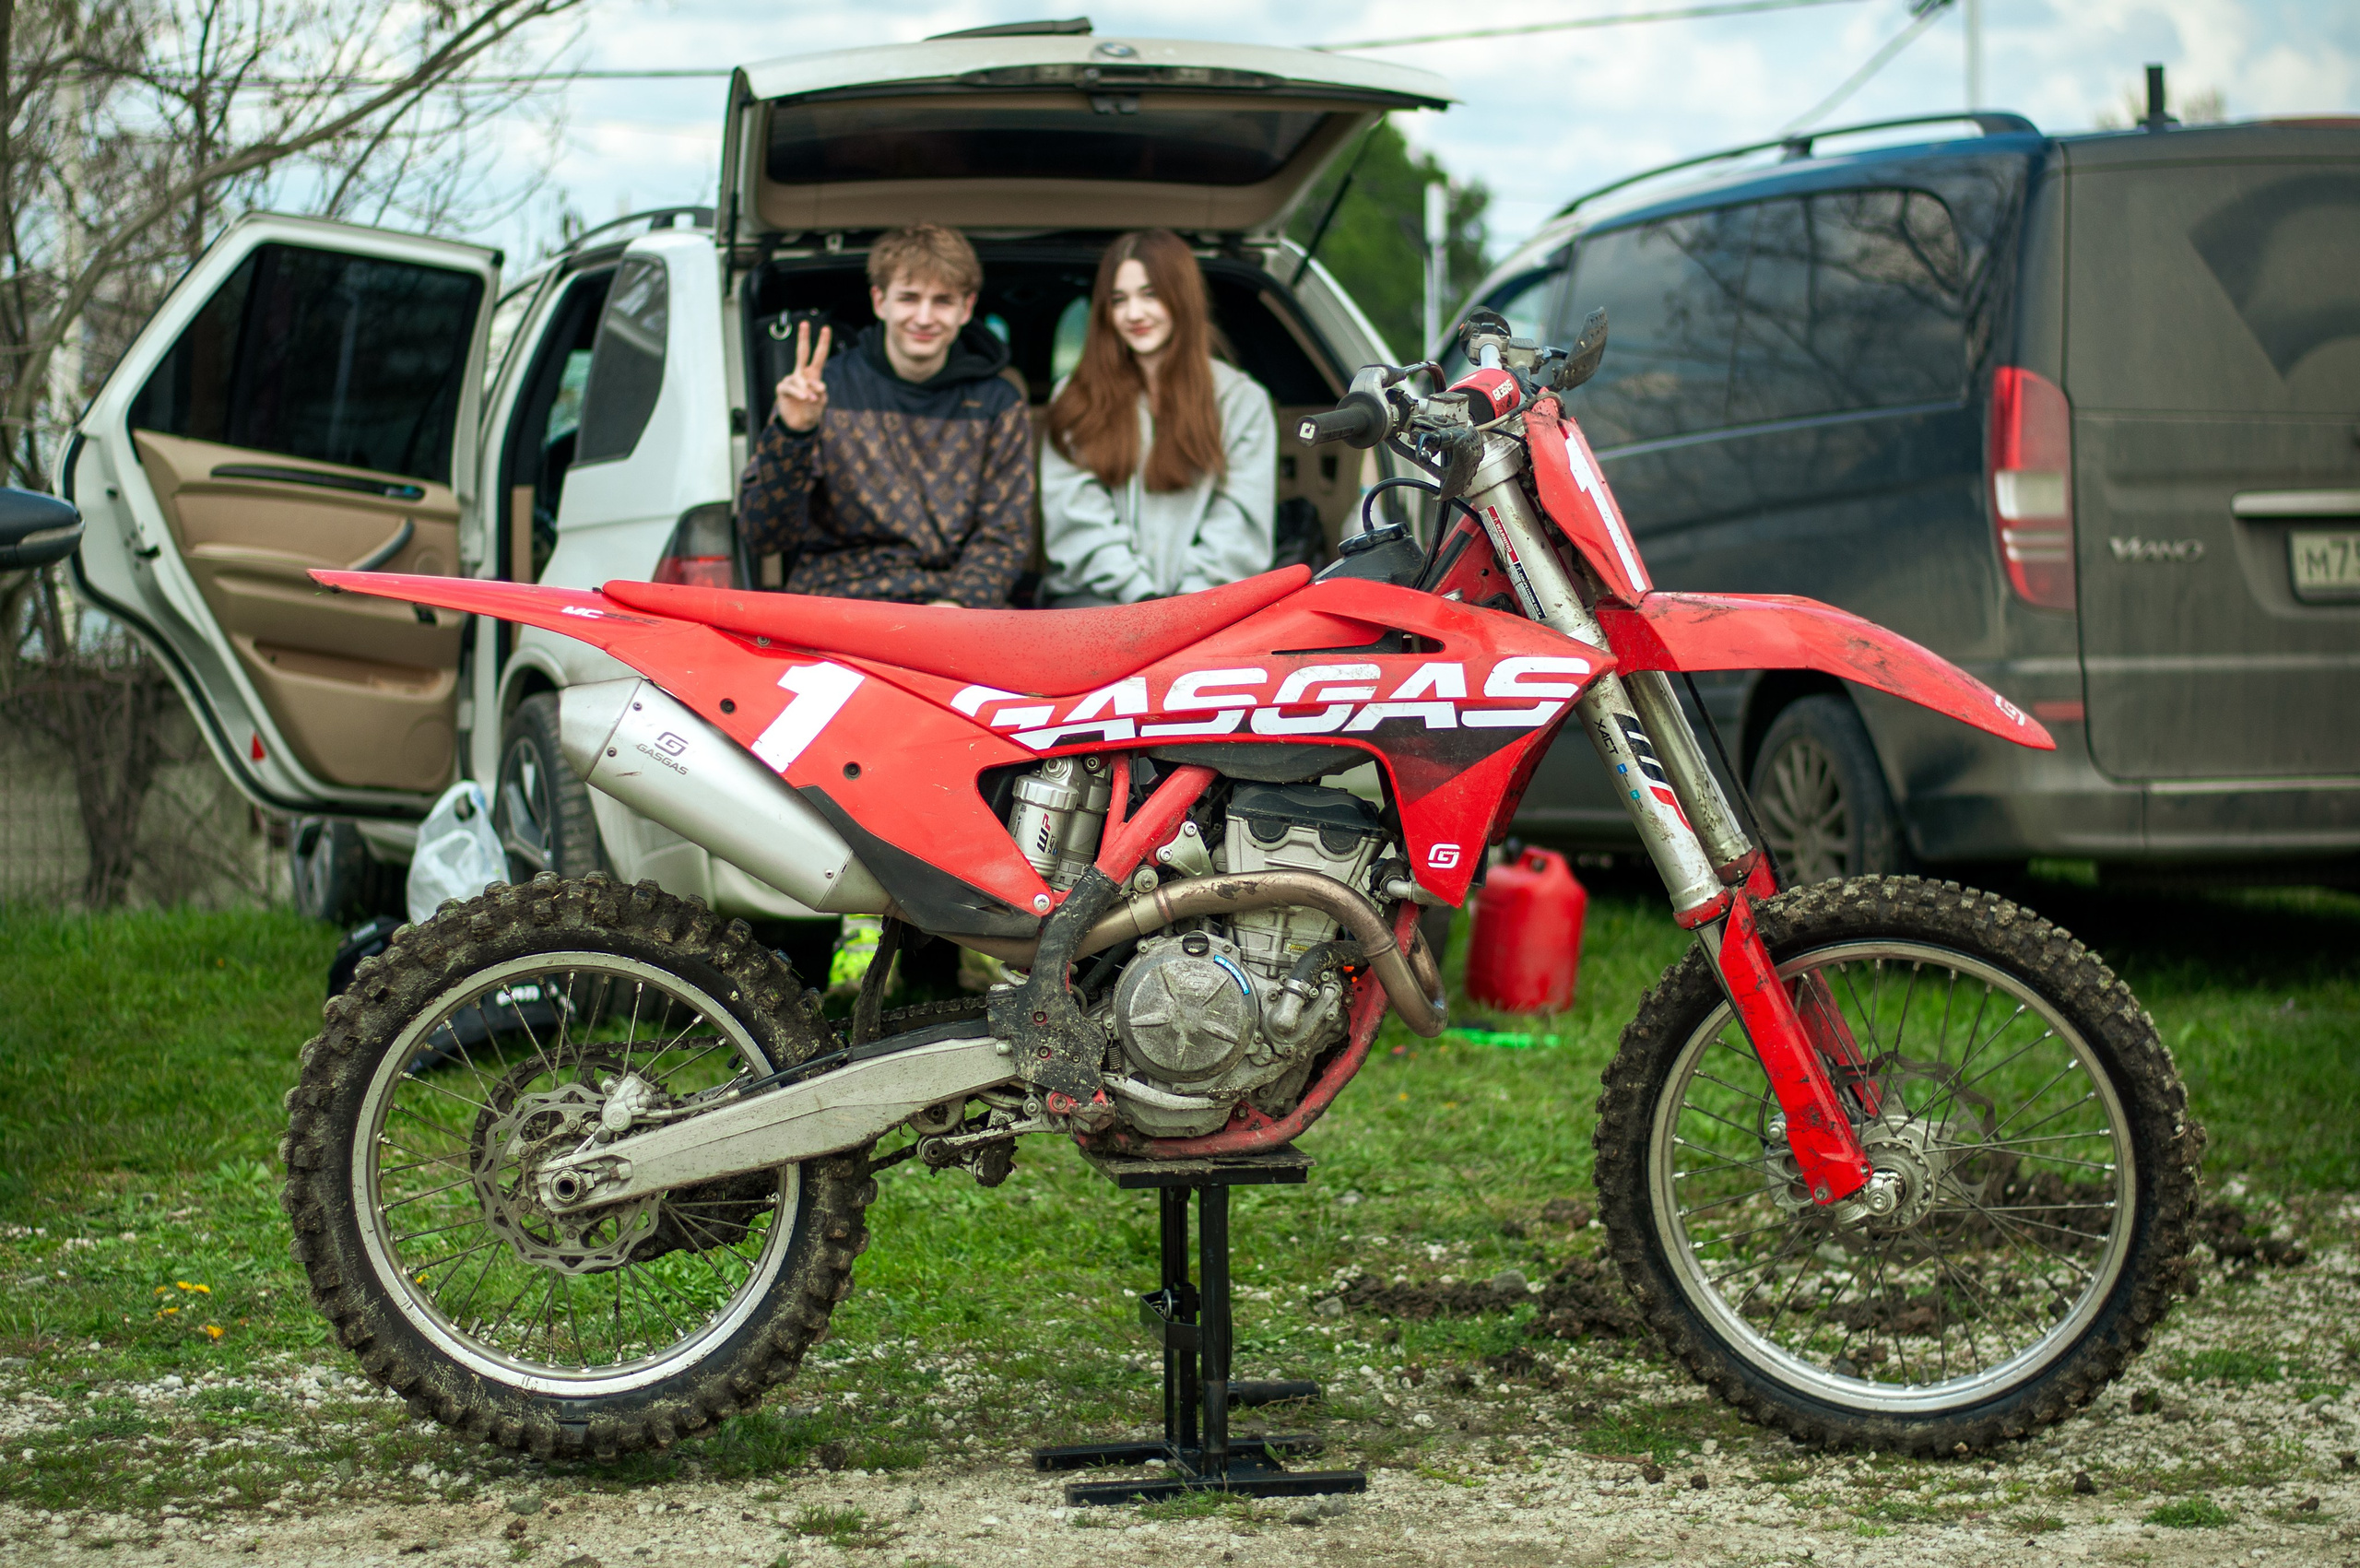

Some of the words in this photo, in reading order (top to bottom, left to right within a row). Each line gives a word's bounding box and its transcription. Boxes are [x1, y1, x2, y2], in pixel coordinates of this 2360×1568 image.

[1565, 432, 1646, 593] 1
[1495, 523, 1513, 553] WARNING
[561, 606, 604, 619] MC
[750, 661, 866, 772] 1
[950, 656, 1591, 751] GASGAS
[1594, 718, 1620, 755] XACT
[636, 743, 690, 775] GASGAS
[1037, 812, 1051, 854] WP
